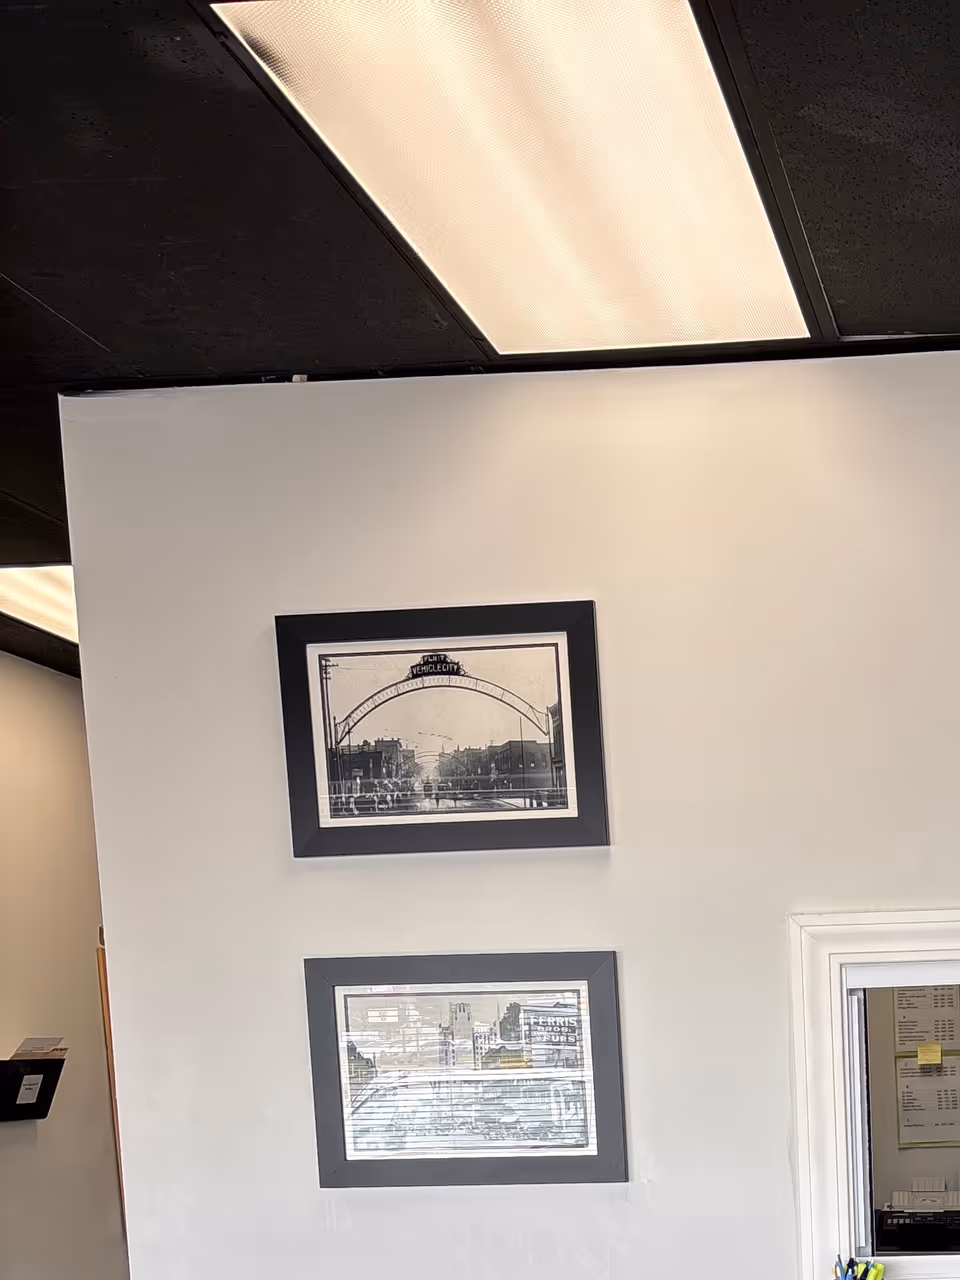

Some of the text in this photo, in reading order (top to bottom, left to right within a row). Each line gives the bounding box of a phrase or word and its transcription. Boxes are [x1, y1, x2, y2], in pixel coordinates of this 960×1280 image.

[412, 663, 458, 674] VEHICLE CITY
[530, 1015, 577, 1026] FERRIS
